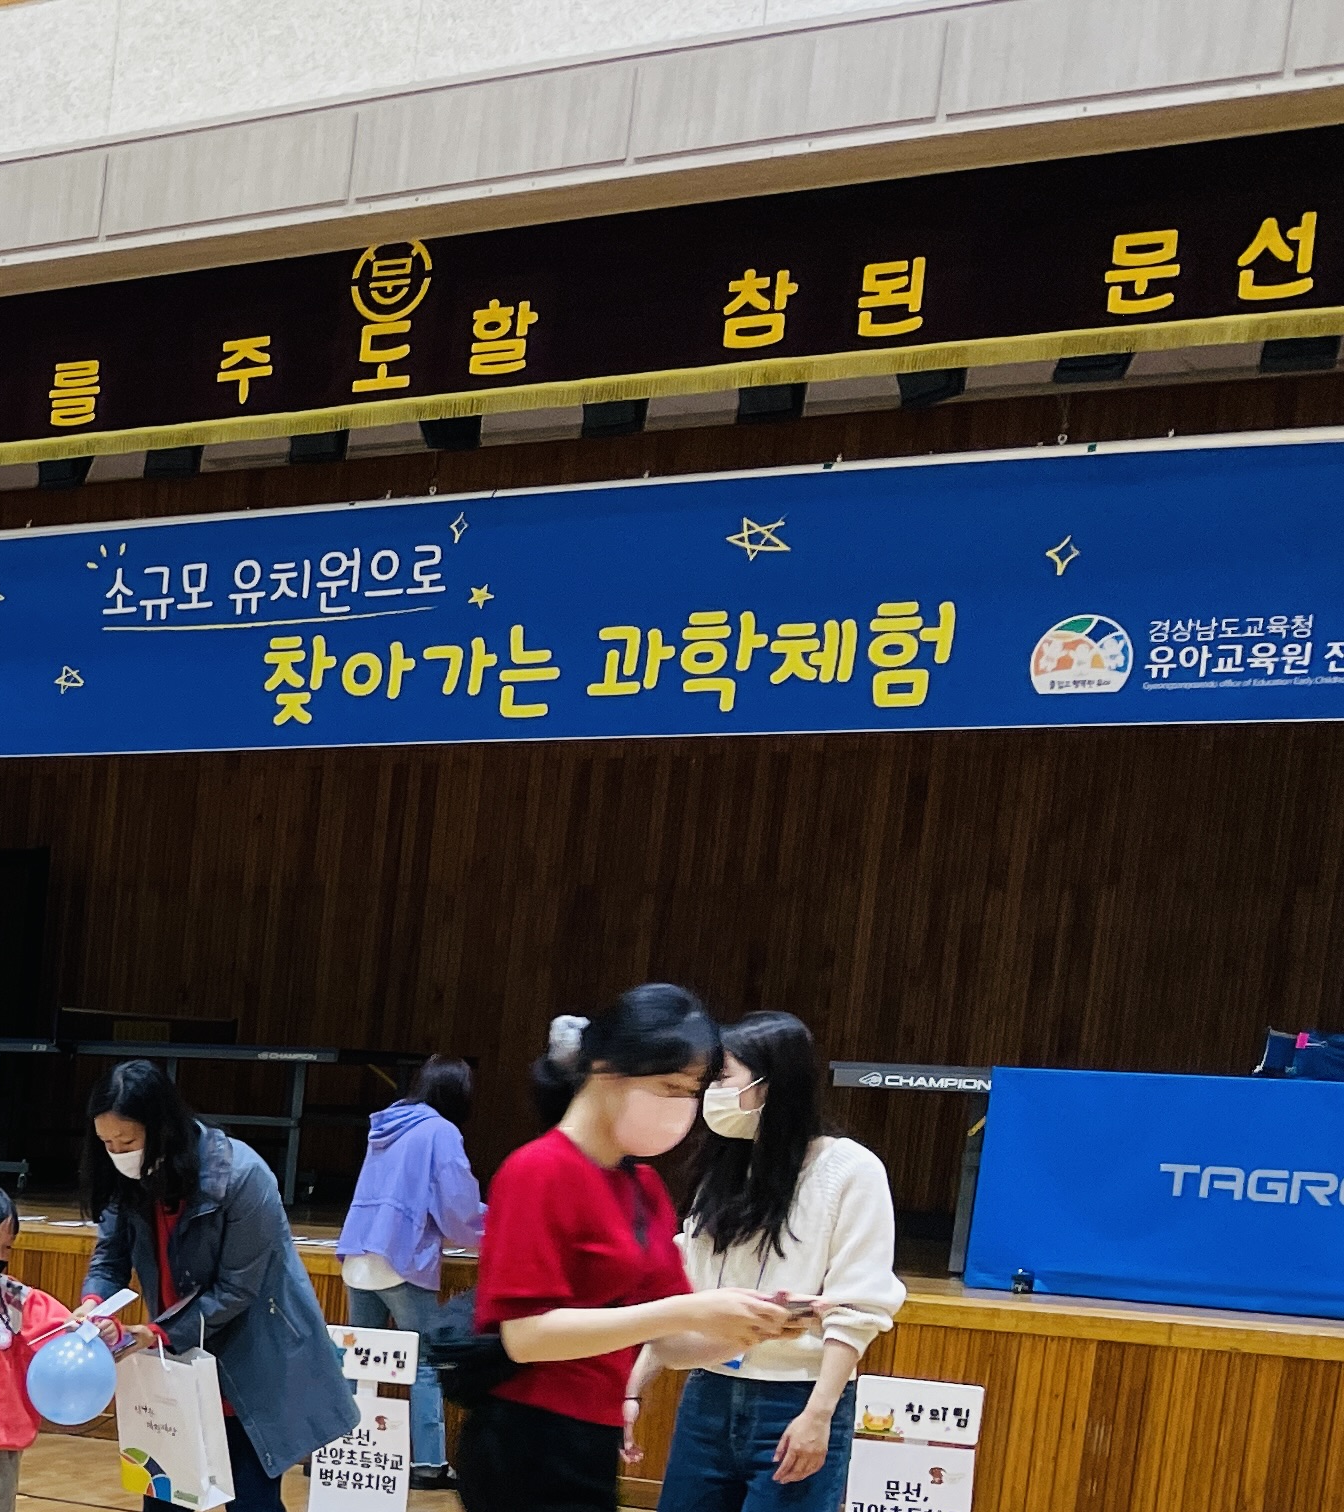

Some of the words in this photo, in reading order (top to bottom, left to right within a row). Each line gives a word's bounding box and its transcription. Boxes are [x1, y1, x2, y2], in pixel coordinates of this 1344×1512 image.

[722, 255, 926, 349] 참된
[102, 562, 214, 621] 소규모
[228, 545, 447, 614] 유치원으로
[1148, 614, 1315, 644] 경상남도교육청
[262, 624, 561, 726] 찾아가는
[587, 600, 955, 713] 과학체험
[1143, 640, 1313, 680] 유아교육원
[884, 1075, 992, 1091] CHAMPION
[1159, 1163, 1344, 1207] TAGR
[904, 1402, 971, 1429] 창의팀
[319, 1468, 397, 1495] 병설유치원
[884, 1480, 929, 1503] 문선,
